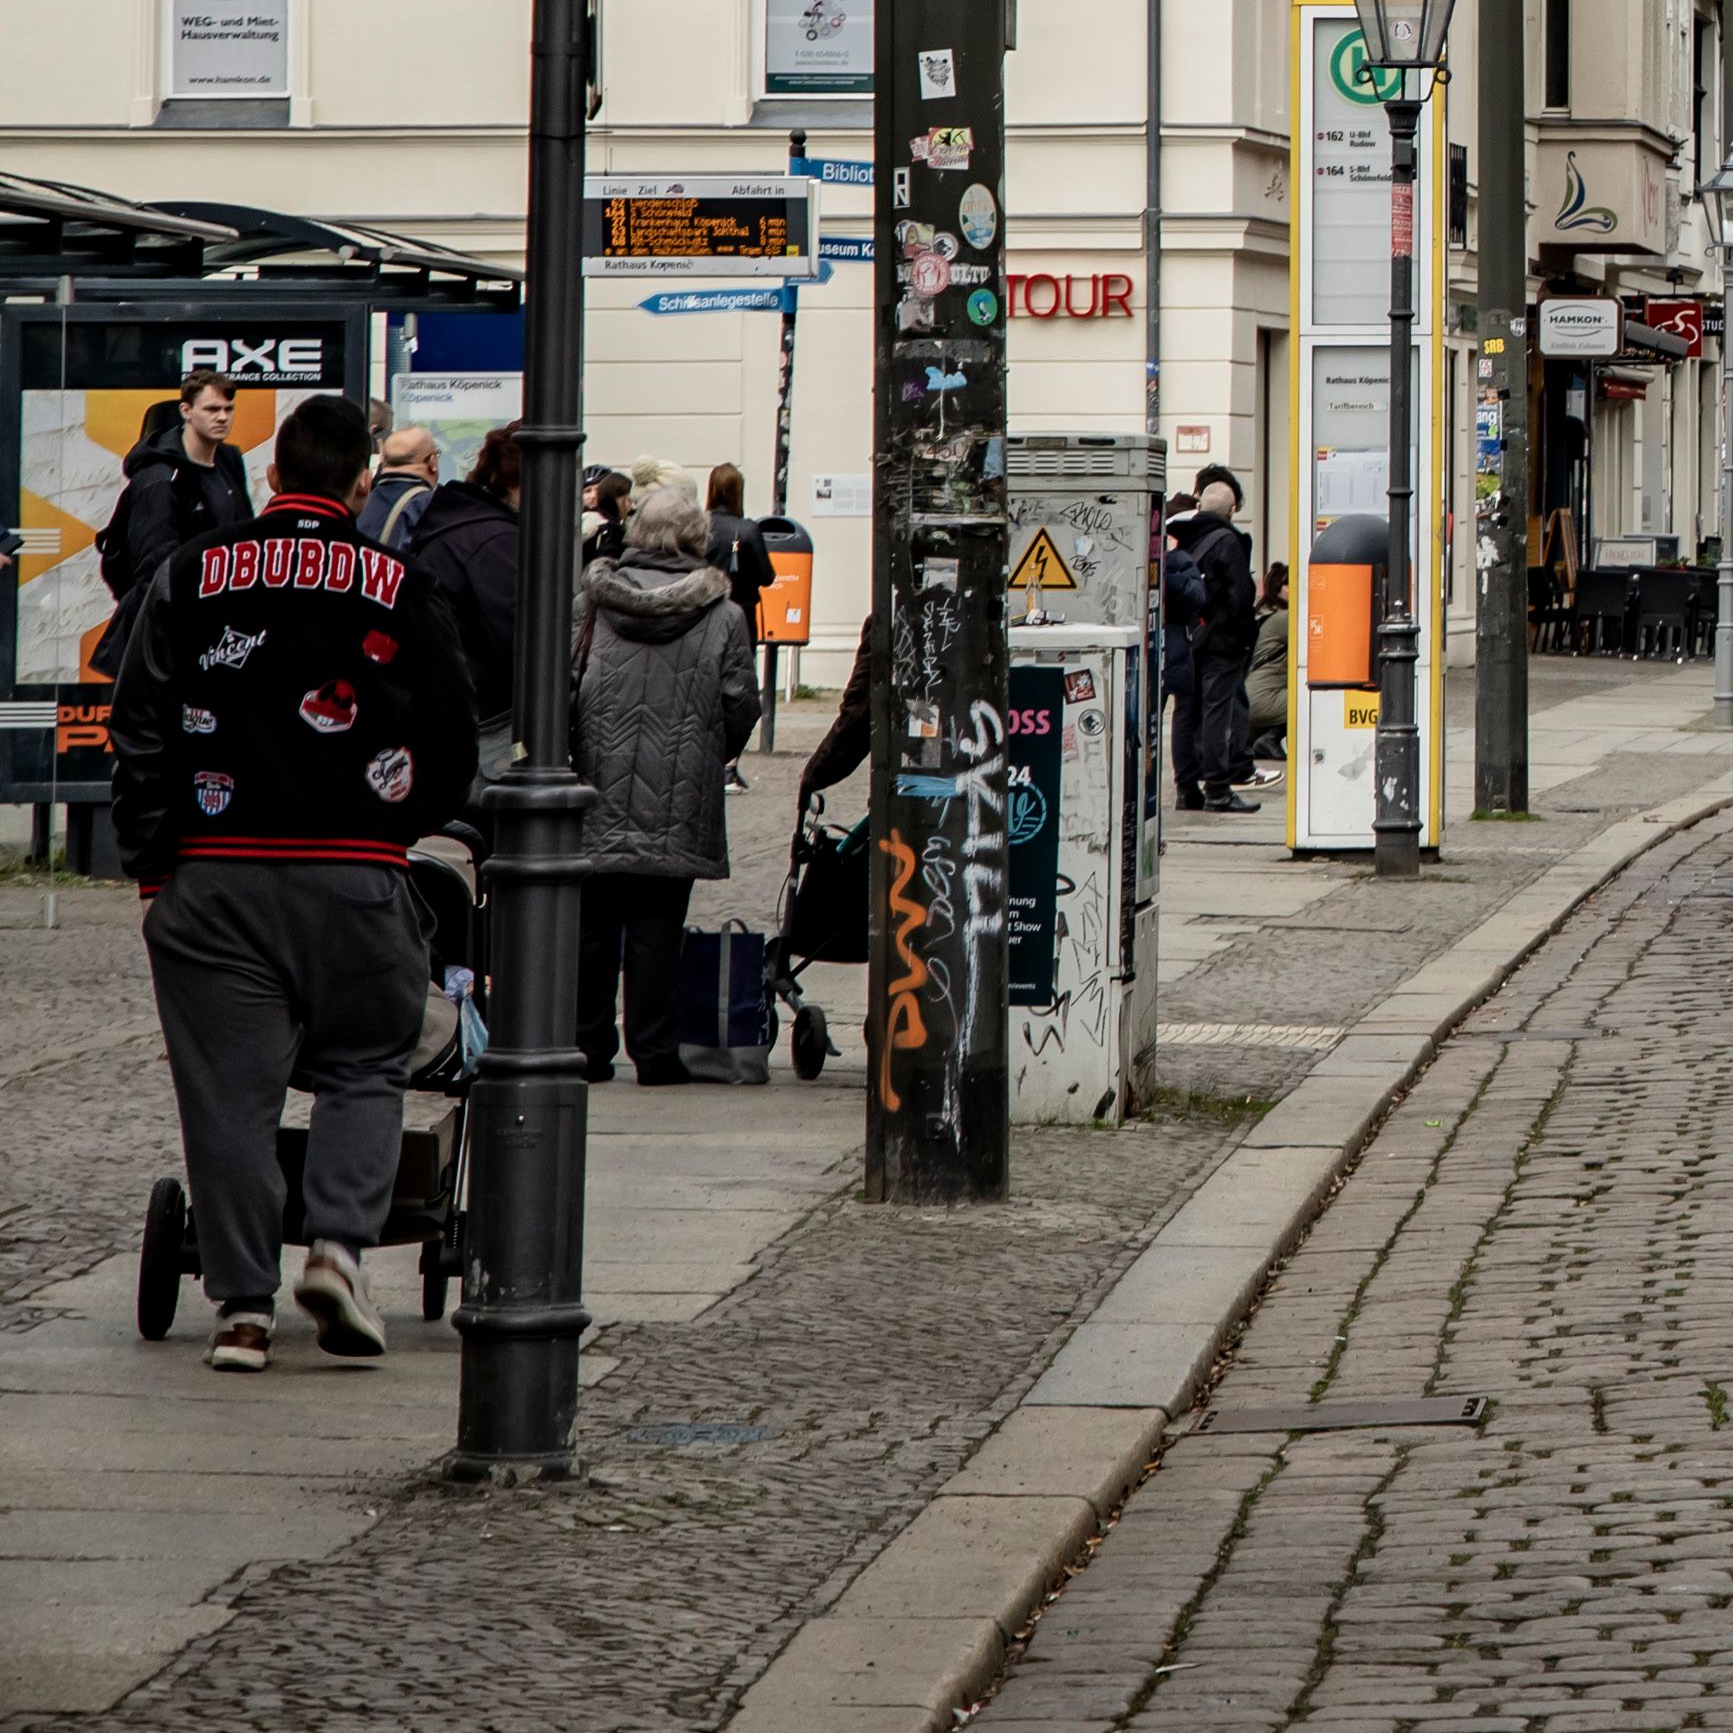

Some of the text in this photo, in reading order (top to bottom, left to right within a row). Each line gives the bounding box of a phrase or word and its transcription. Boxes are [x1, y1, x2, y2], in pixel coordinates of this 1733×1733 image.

[181, 15, 280, 27] WEG- und Miet-
[181, 29, 280, 43] Hausverwaltung
[1325, 131, 1344, 142] 162
[1325, 165, 1345, 176] 164
[602, 185, 785, 196] Linie Ziel Abfahrt in
[604, 259, 647, 270] Rathaus
[1549, 315, 1602, 324] HAMKON
[1483, 338, 1505, 355] SRB
[181, 338, 323, 373] AXE
[262, 372, 323, 382] COLLECTION
[1325, 376, 1357, 385] Rathaus
[449, 378, 503, 392] Köpenick
[1328, 402, 1375, 410] Tarifbereich
[199, 537, 405, 610] DBUBDW
[199, 629, 267, 671] Vincent
[1349, 708, 1378, 725] BVG
[1013, 921, 1042, 933] Show
